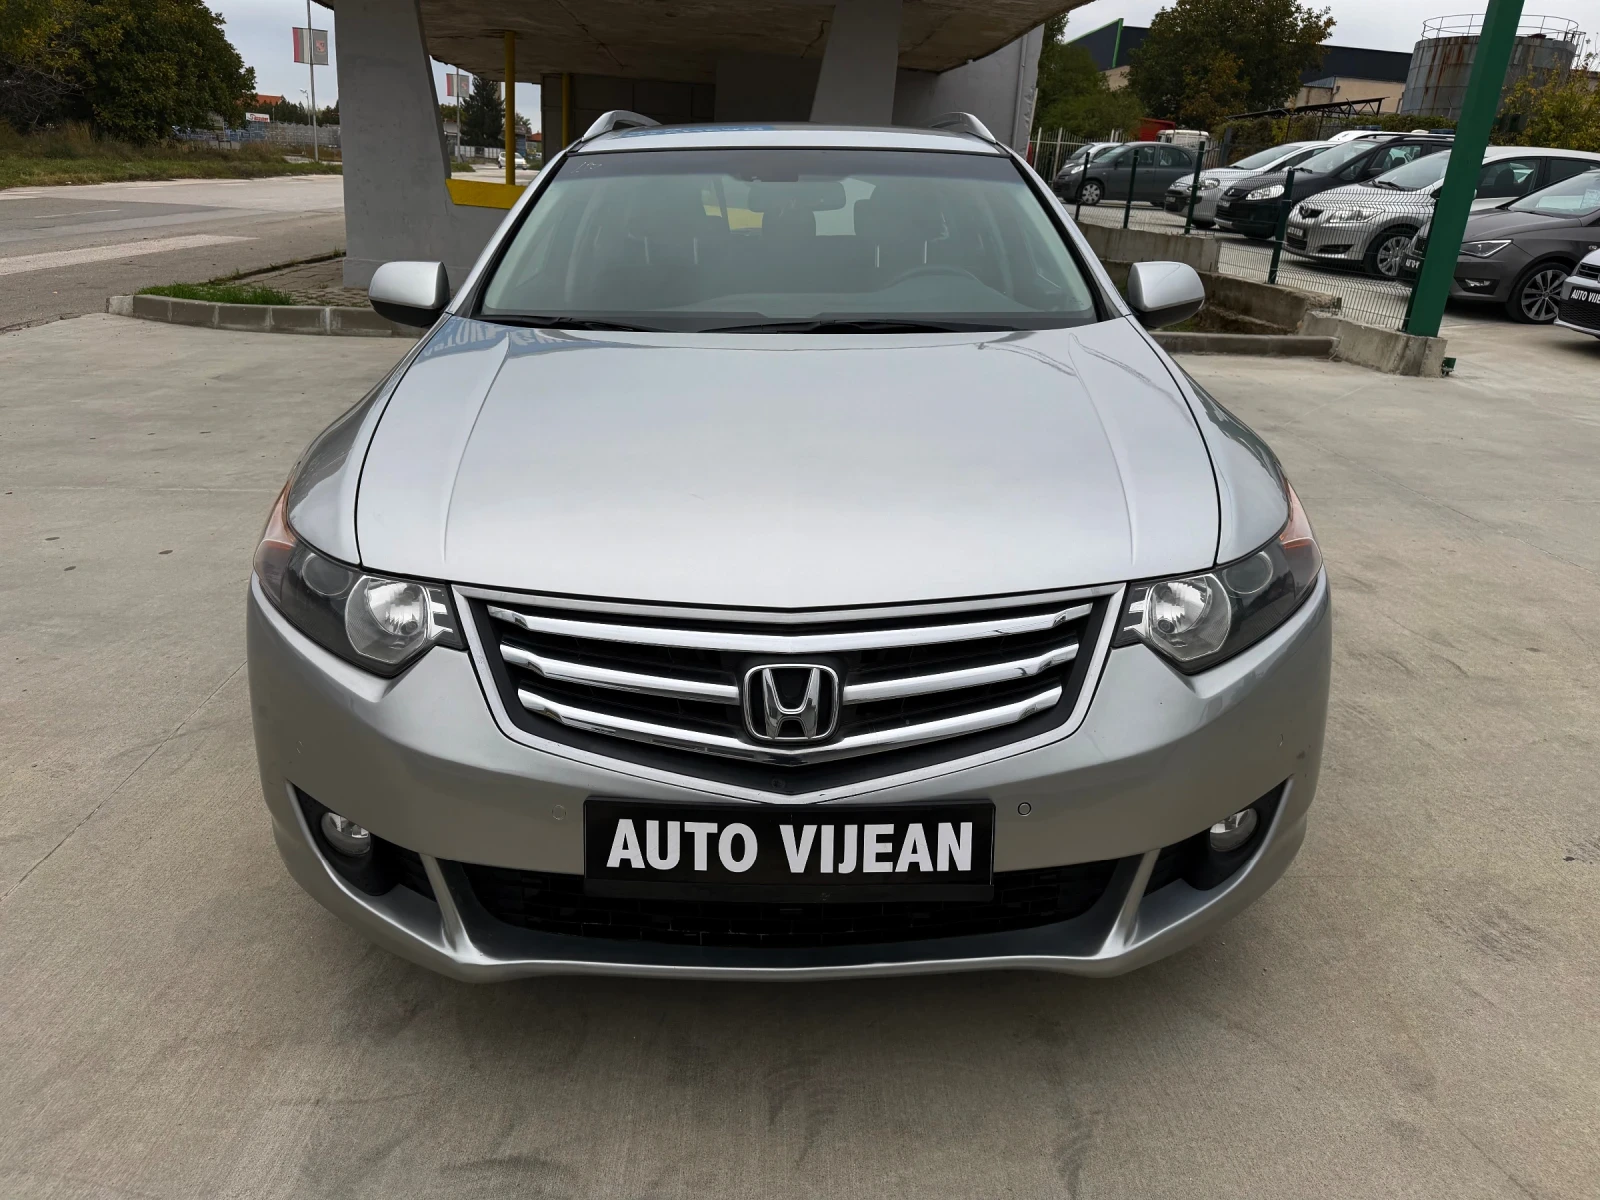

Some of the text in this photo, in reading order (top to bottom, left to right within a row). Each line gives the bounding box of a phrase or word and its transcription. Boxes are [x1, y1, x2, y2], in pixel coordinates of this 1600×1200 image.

[1570, 289, 1588, 301] AUTO
[606, 818, 973, 874] AUTO VIJEAN
